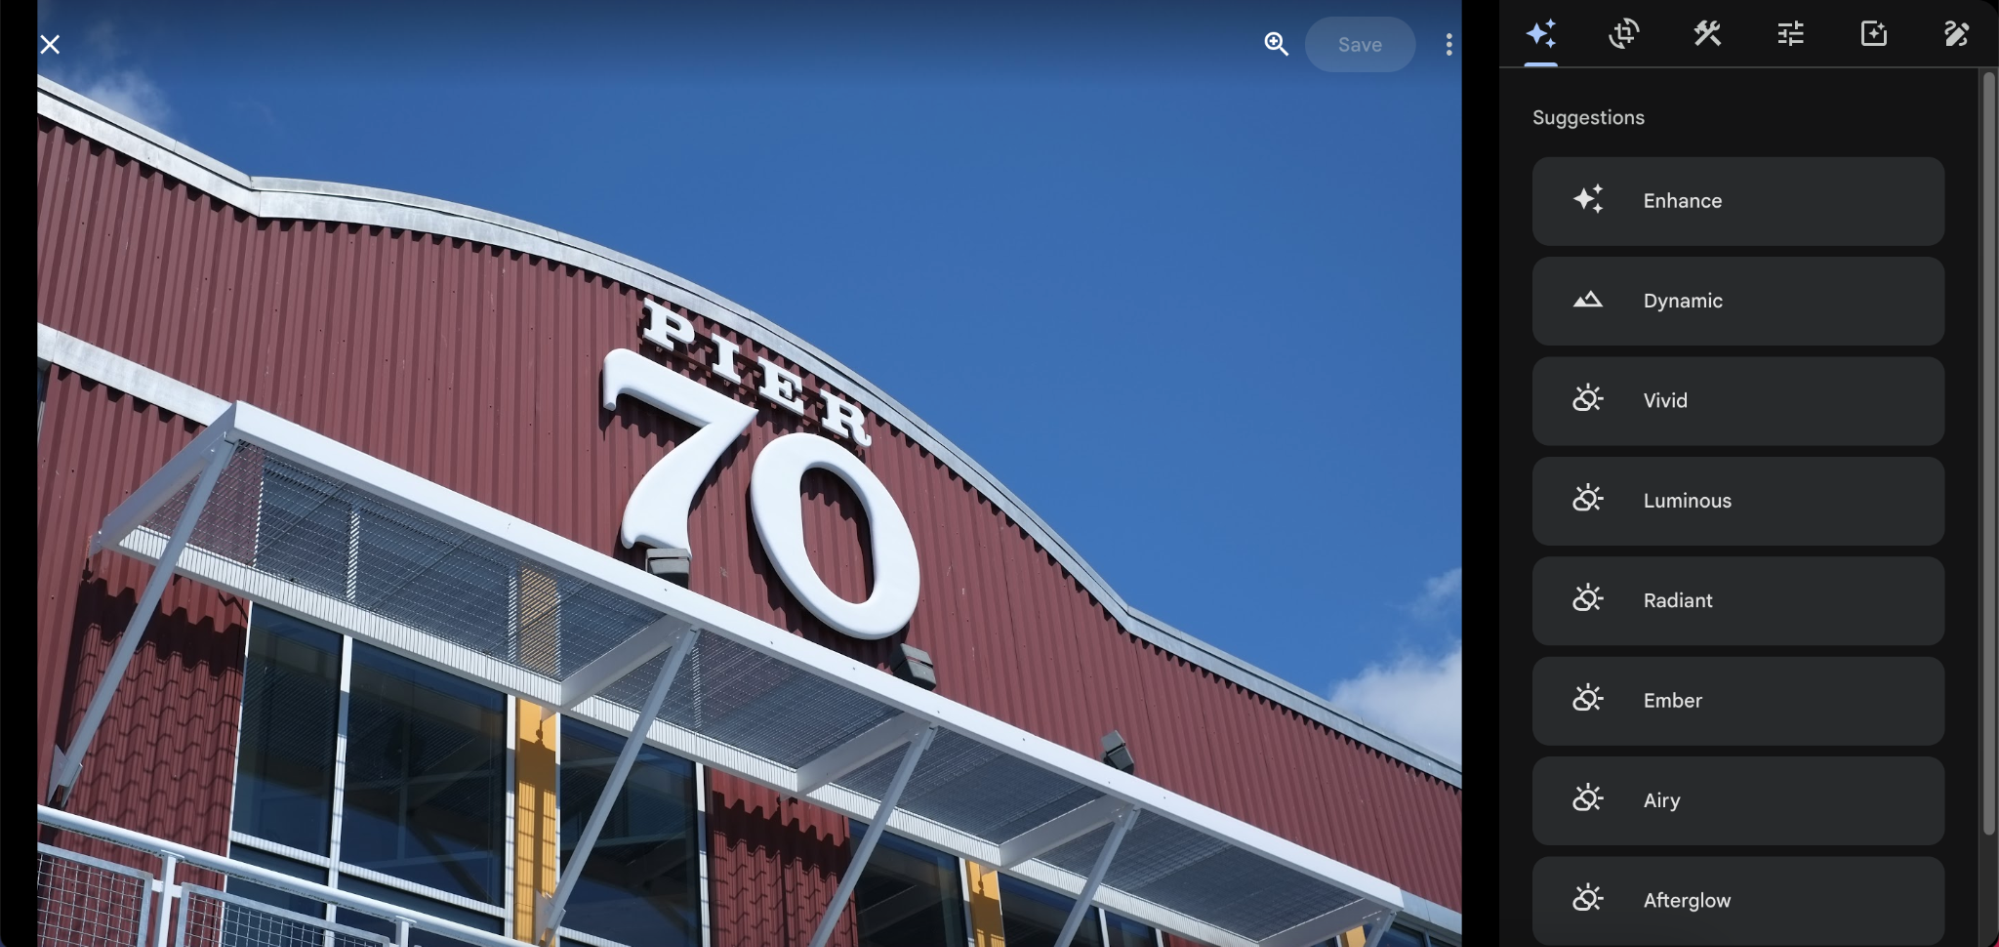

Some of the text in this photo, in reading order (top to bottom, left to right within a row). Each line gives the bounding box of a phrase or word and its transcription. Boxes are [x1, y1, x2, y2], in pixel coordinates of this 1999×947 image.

[1339, 37, 1382, 52] Save
[1533, 109, 1645, 129] Suggestions
[1645, 192, 1722, 208] Enhance
[1645, 292, 1723, 312] Dynamic
[643, 298, 872, 447] PIER
[1644, 392, 1687, 408] Vivid
[603, 348, 921, 641] 70
[1645, 492, 1732, 508] Luminous
[1645, 592, 1713, 608] Radiant
[1645, 692, 1703, 708] Ember
[1644, 792, 1681, 812] Airy
[1644, 892, 1731, 912] Afterglow
